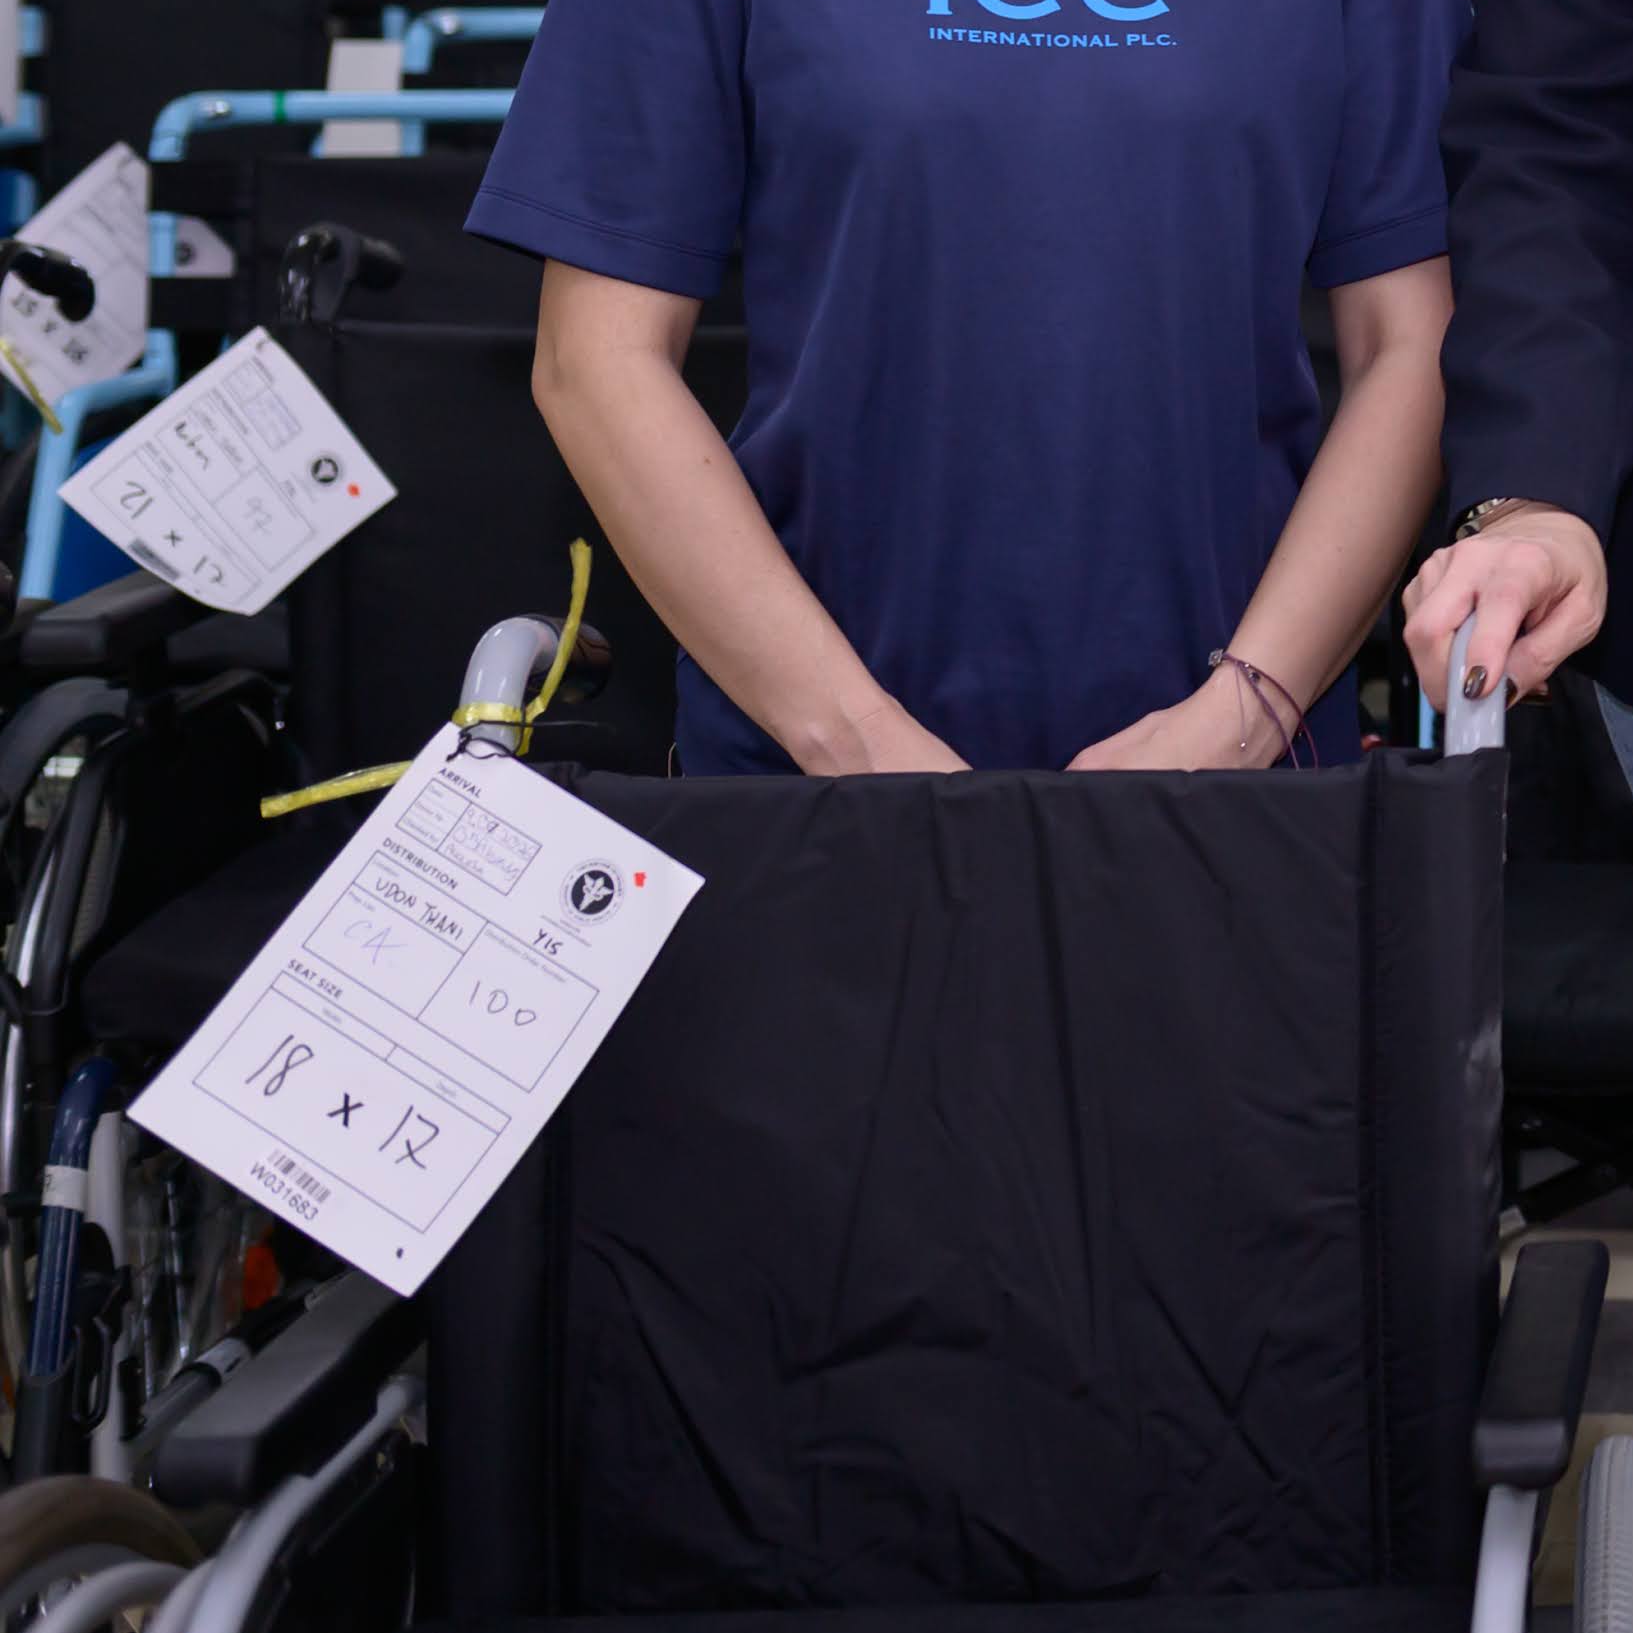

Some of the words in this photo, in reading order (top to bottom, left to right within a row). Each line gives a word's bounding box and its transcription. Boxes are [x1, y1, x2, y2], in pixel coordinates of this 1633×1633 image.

[929, 28, 1119, 47] INTERNATIONAL
[1126, 33, 1177, 46] PLC.
[438, 767, 481, 798] ARRIVAL
[381, 838, 459, 890] DISTRIBUTION
[376, 878, 417, 908] UDON
[419, 902, 463, 941] THANI
[288, 959, 317, 980] SEAT
[317, 978, 342, 998] SIZE
[245, 1034, 315, 1096] 18
[250, 1163, 320, 1221] W031683
